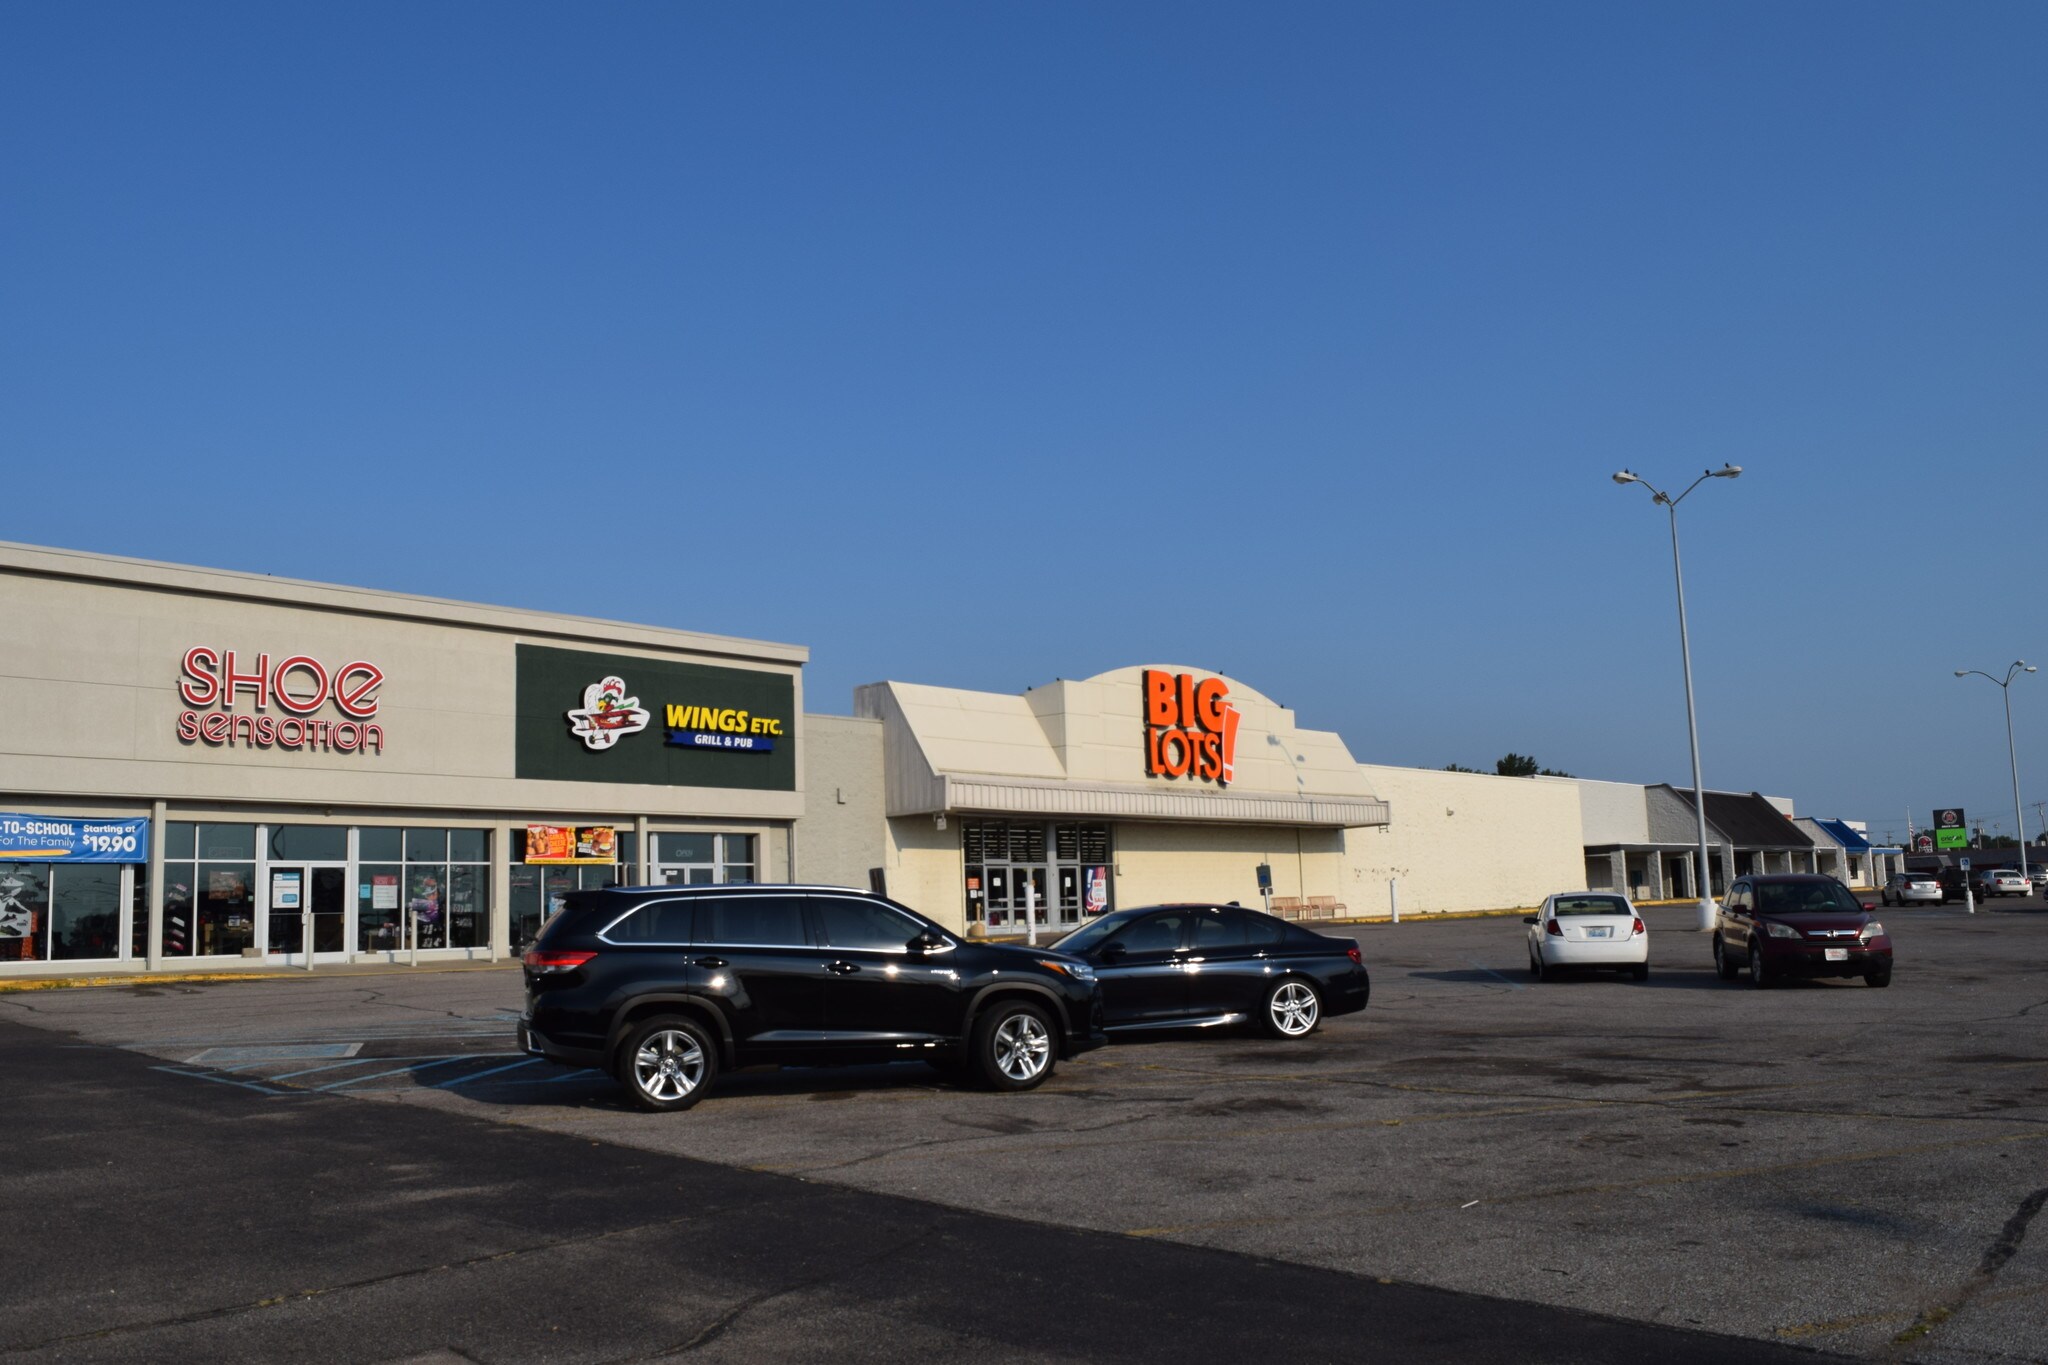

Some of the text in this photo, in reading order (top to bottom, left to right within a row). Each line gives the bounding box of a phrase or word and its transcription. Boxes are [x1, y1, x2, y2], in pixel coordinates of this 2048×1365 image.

[1148, 669, 1233, 733] BIG
[666, 703, 784, 735] WINGS ETC.
[695, 734, 753, 748] GRILL & PUB
[83, 824, 136, 835] Starting at
[18, 836, 38, 846] The
[40, 837, 76, 849] Family
[82, 834, 137, 852] $19.90
